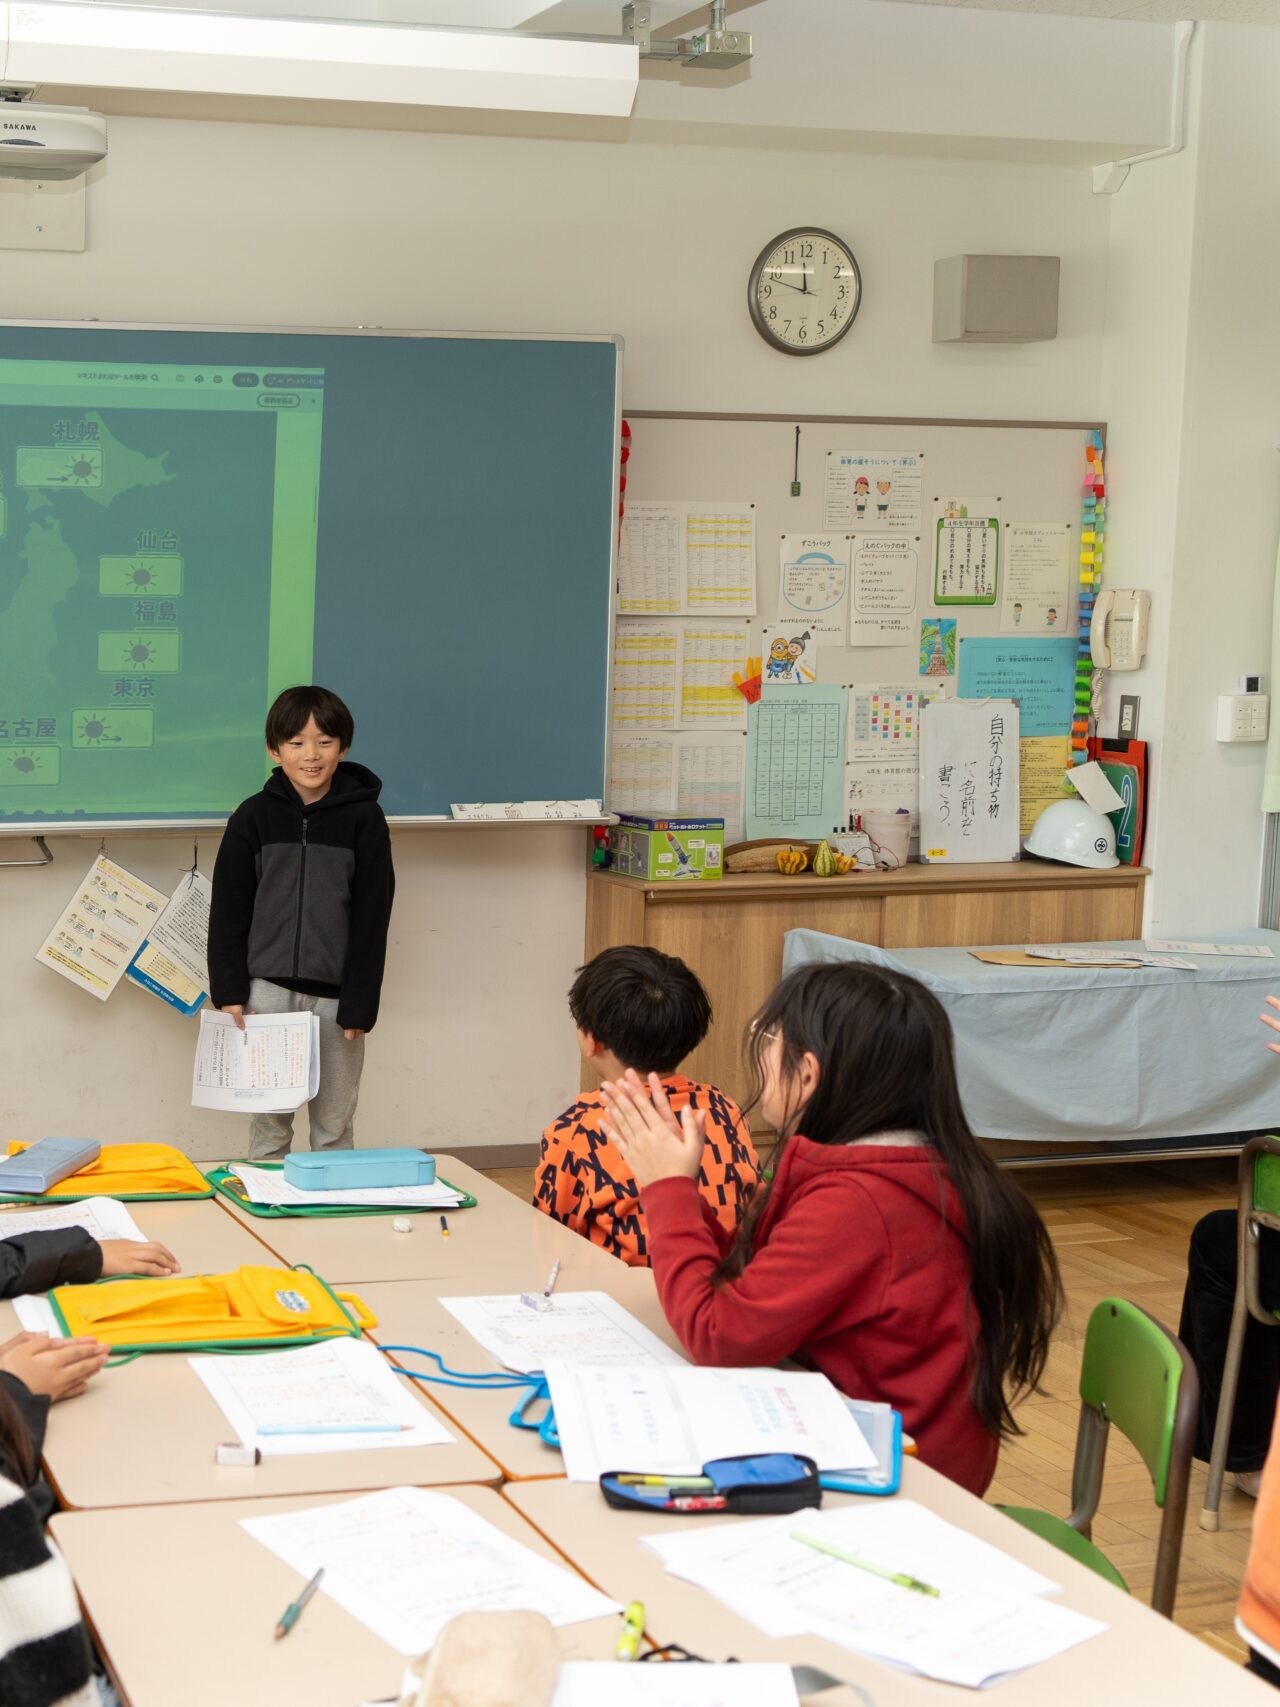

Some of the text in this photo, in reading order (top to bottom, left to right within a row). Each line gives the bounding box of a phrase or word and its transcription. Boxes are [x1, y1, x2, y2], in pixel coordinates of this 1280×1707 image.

[3, 123, 37, 131] SAKAWA
[784, 250, 795, 264] 11
[800, 244, 813, 258] 12
[822, 250, 828, 264] 1
[769, 265, 782, 280] 10
[833, 265, 841, 279] 2
[764, 285, 772, 299] 9
[837, 285, 845, 300] 3
[769, 305, 777, 320] 8
[829, 305, 838, 320] 4
[783, 319, 792, 334] 7
[798, 324, 807, 339] 6
[816, 319, 825, 335] 5
[54, 421, 100, 442] 札幌
[136, 530, 179, 552] 仙台
[135, 601, 178, 623] 福島
[113, 677, 156, 699] 東京
[988, 714, 1004, 819] 自分の持ち物
[959, 761, 977, 837] に名前を
